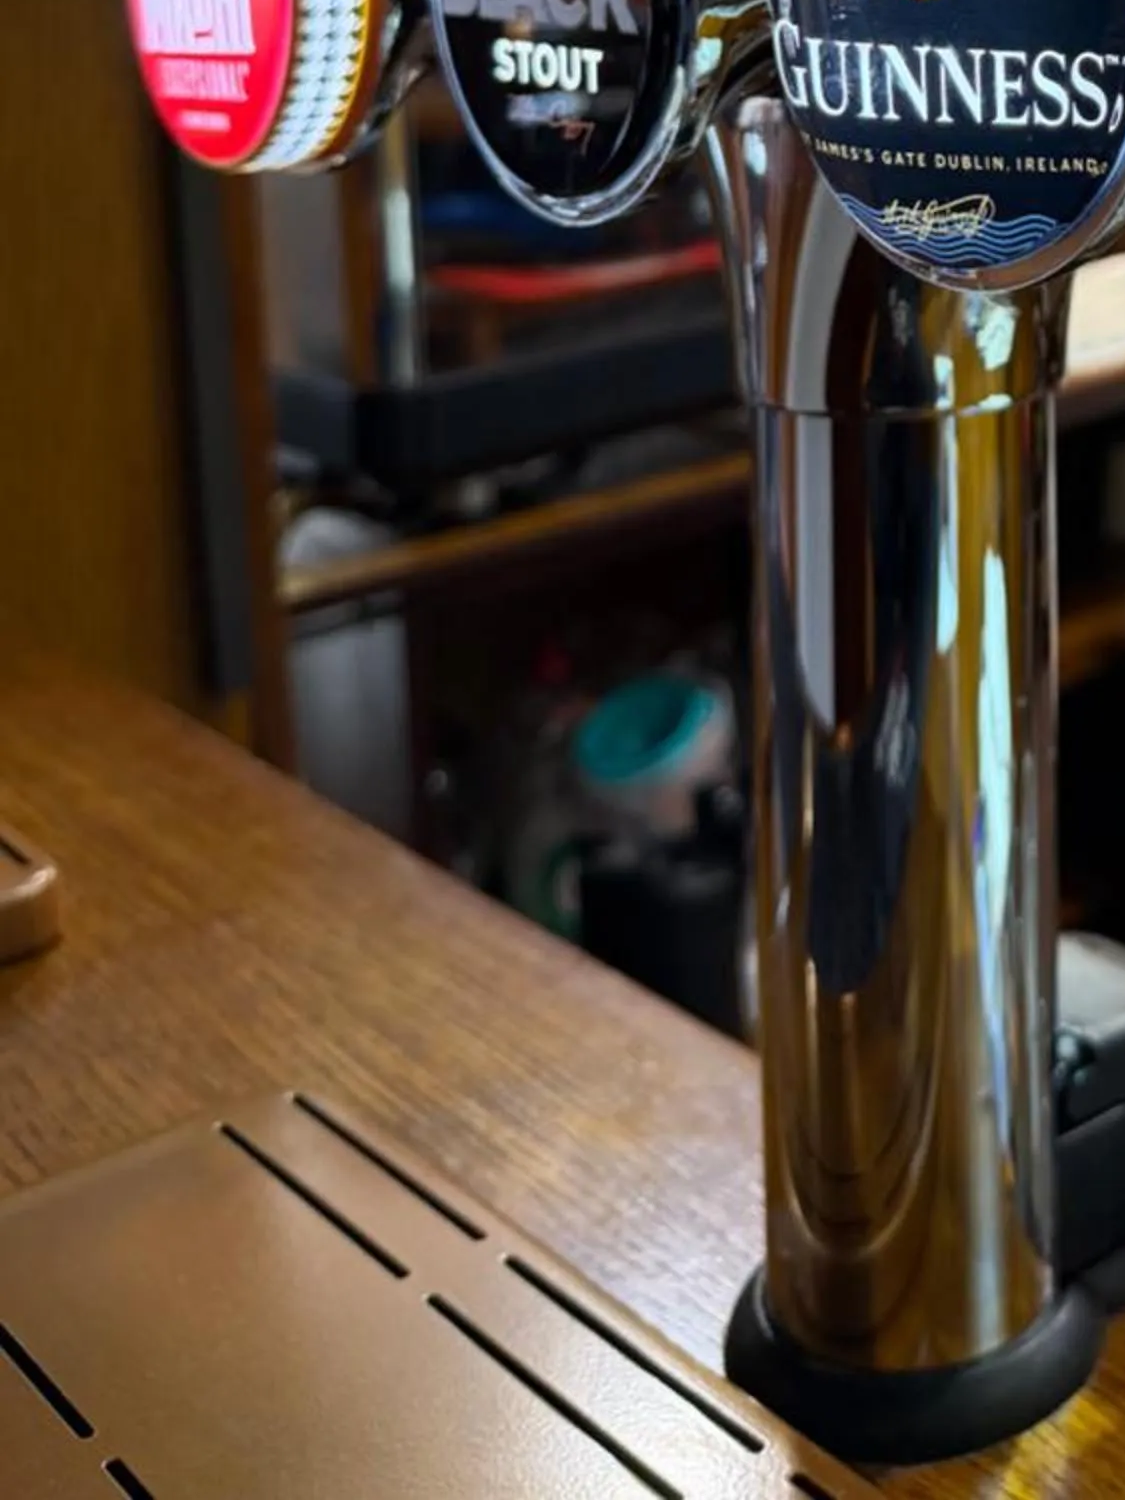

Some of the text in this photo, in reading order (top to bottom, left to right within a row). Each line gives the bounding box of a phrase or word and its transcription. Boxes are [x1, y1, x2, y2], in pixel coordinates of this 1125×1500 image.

[491, 37, 604, 94] STOUT
[773, 18, 1108, 129] GUINNESS
[880, 150, 928, 168] GATE
[934, 153, 1011, 173] DUBLIN,
